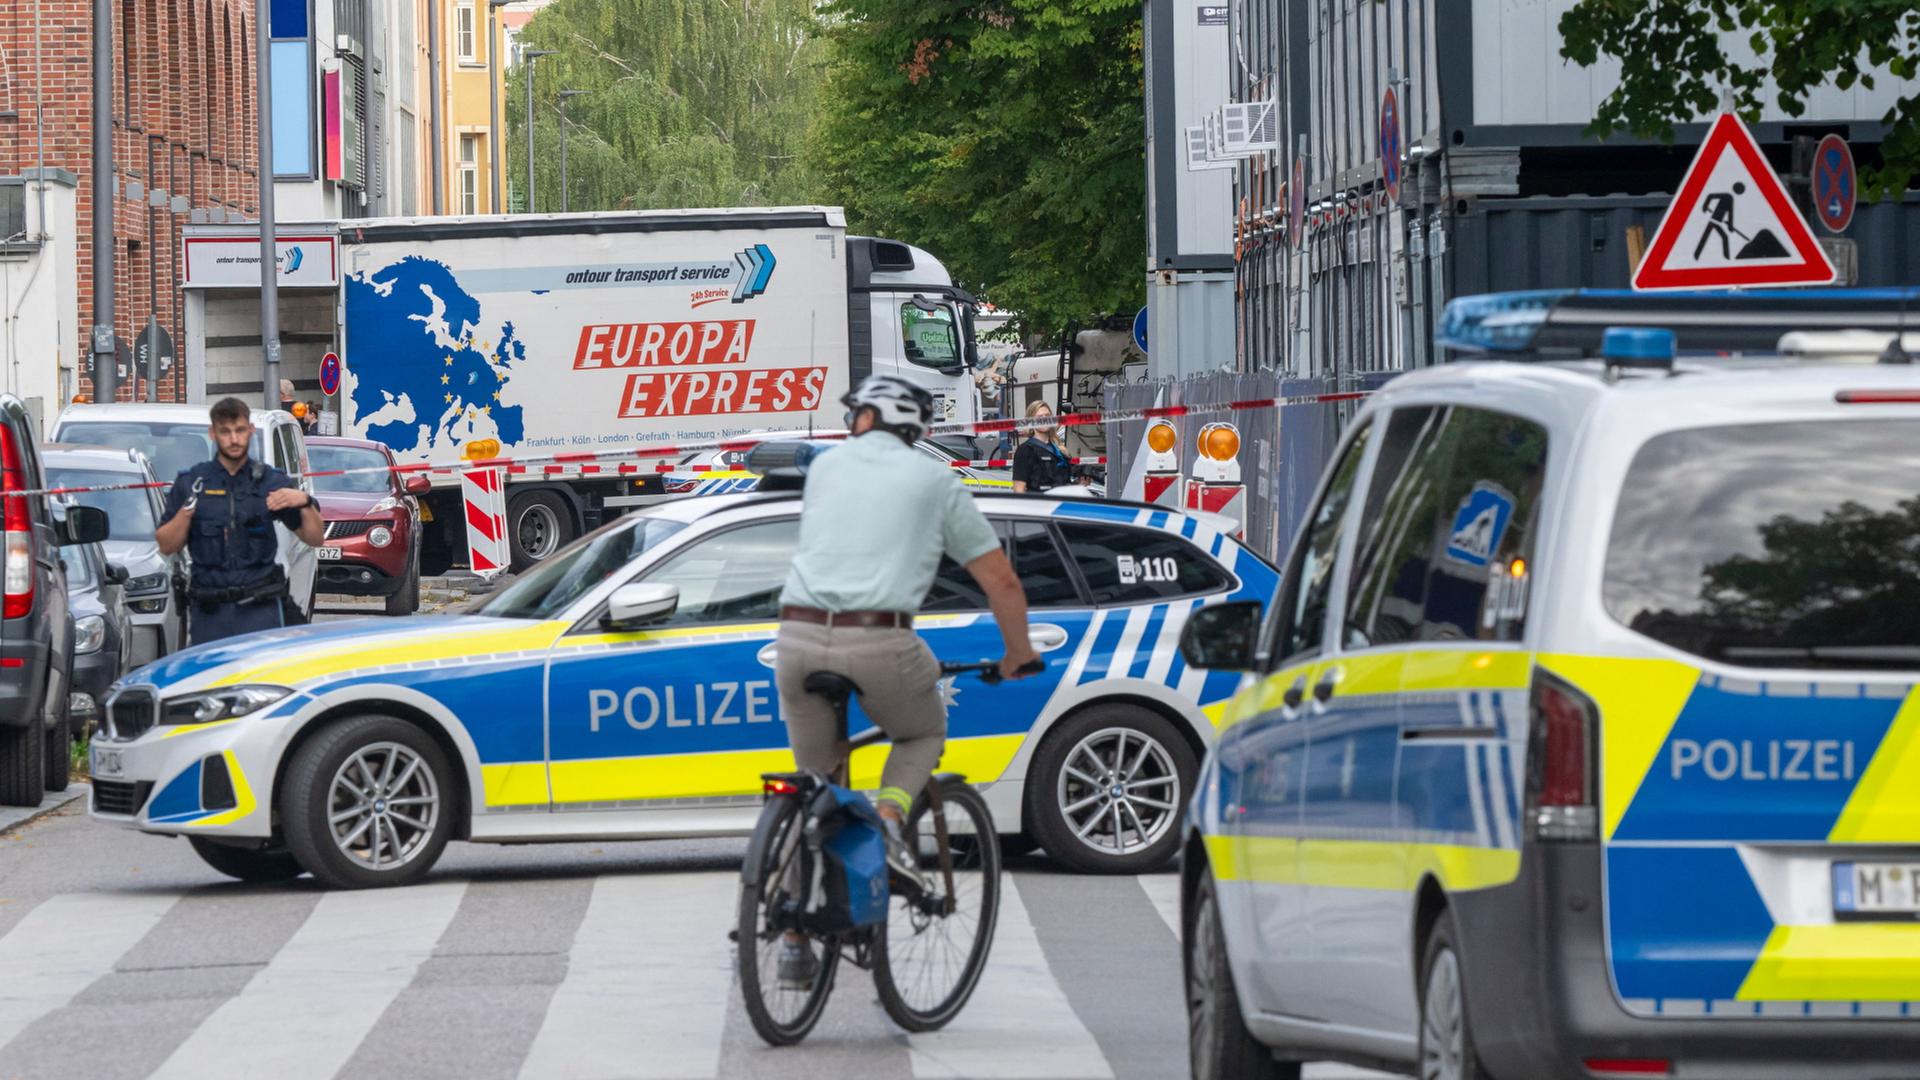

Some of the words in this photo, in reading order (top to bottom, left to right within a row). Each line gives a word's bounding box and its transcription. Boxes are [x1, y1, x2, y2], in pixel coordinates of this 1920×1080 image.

[565, 268, 612, 284] ontour
[614, 266, 678, 283] transport
[680, 265, 730, 280] service
[704, 288, 729, 298] Service
[578, 320, 748, 369] EUROPA
[622, 368, 824, 418] EXPRESS
[526, 434, 565, 447] Frankfurt
[571, 433, 592, 445] Köln
[598, 432, 629, 443] London
[636, 430, 670, 442] Grefrath
[677, 428, 715, 440] Hamburg
[1141, 557, 1178, 581] 110
[1671, 738, 1855, 781] POLIZEI
[1859, 870, 1883, 904] M
